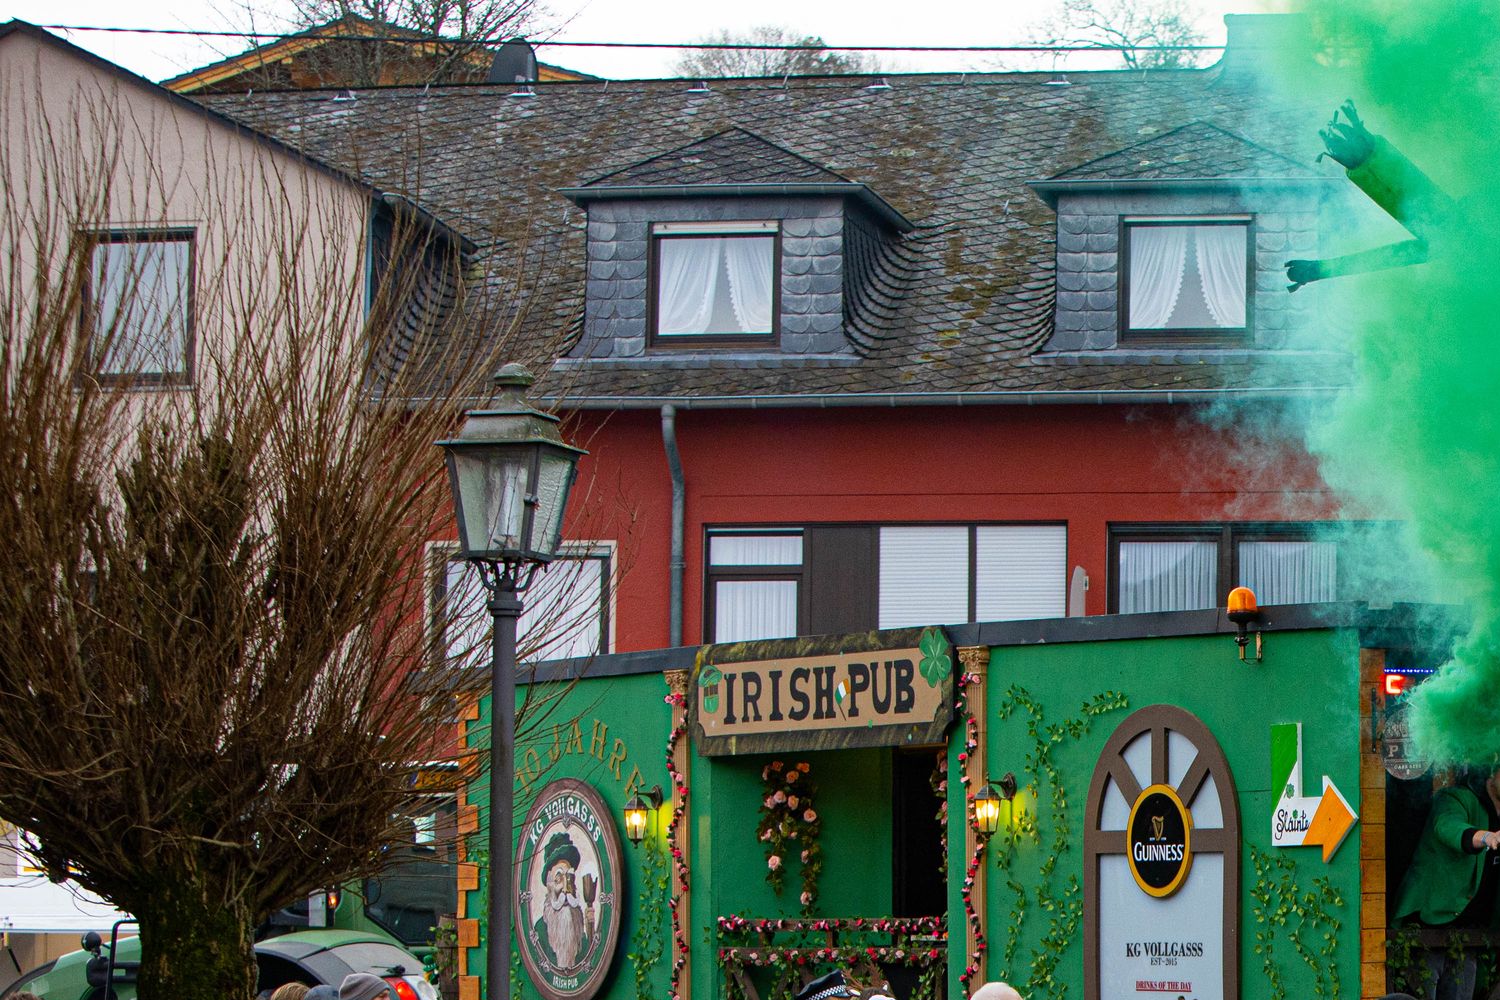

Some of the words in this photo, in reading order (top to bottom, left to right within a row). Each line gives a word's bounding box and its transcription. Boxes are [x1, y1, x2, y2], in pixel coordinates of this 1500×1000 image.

[724, 666, 836, 725] IRISH
[848, 659, 915, 717] PUB
[1134, 842, 1184, 861] GUINNESS
[1126, 943, 1141, 957] KG
[1143, 942, 1203, 957] VOLLGASSS
[1158, 981, 1165, 990] OF
[1167, 981, 1178, 990] THE
[1180, 982, 1192, 991] DAY
